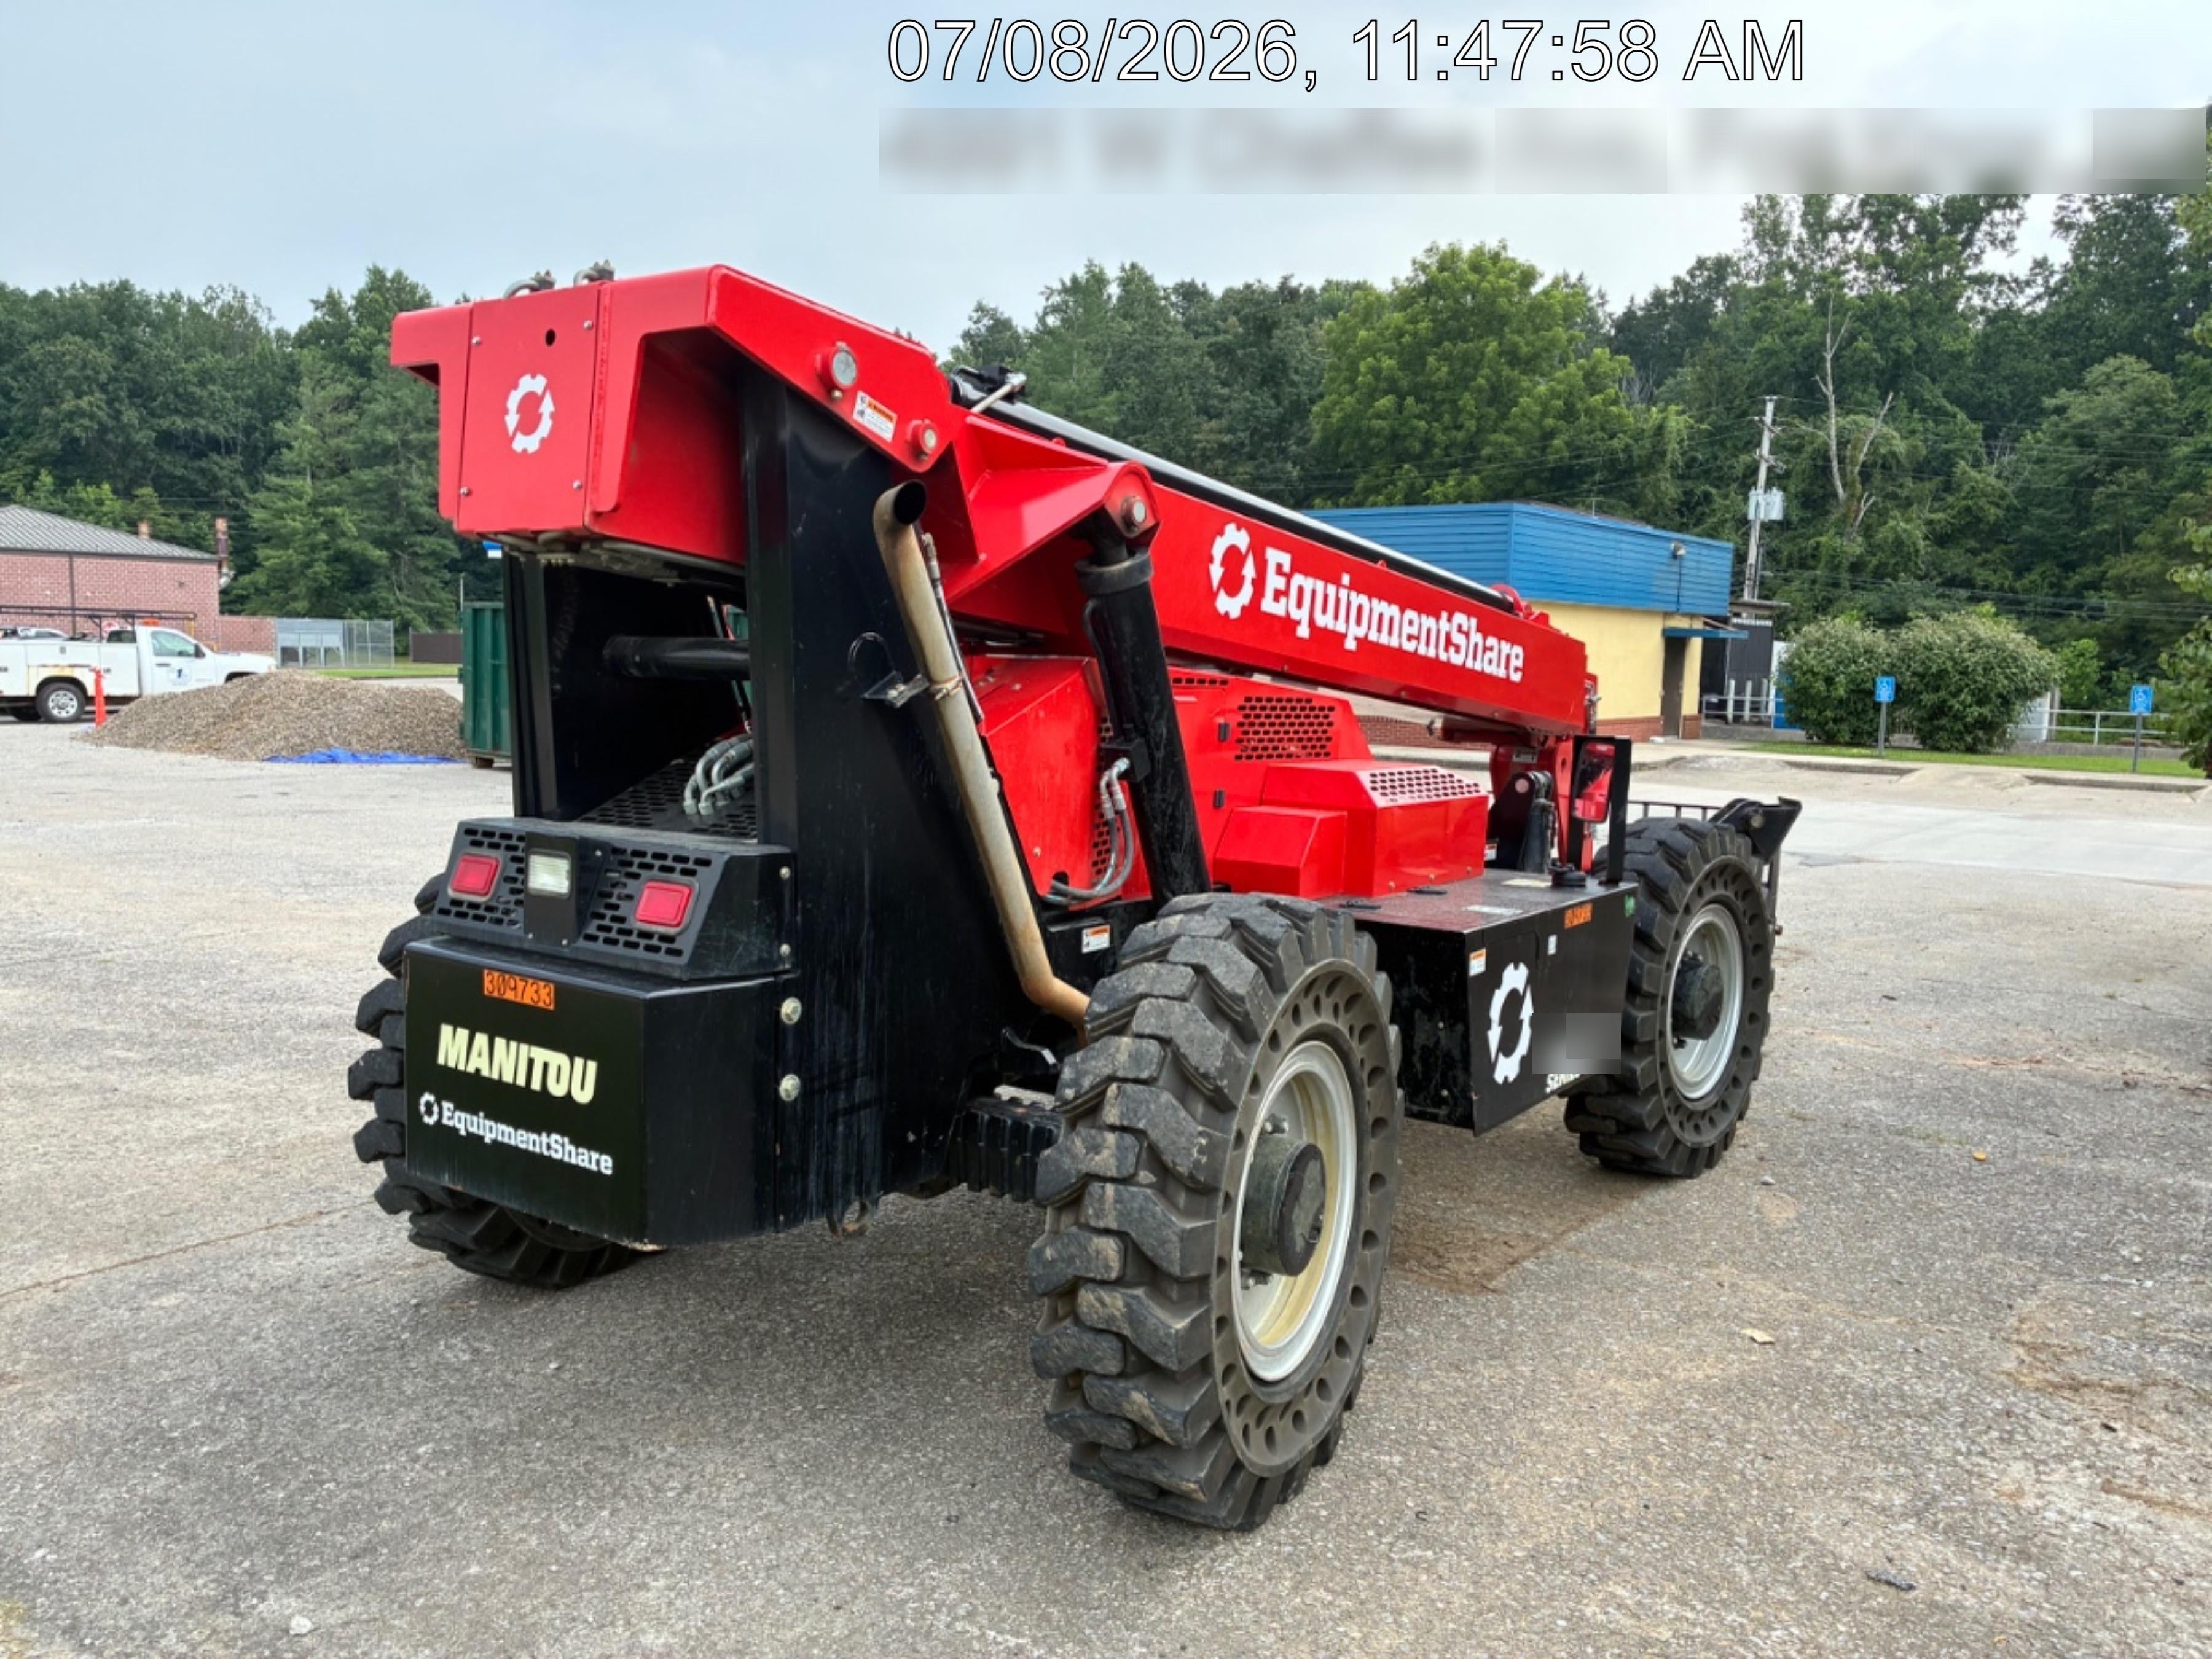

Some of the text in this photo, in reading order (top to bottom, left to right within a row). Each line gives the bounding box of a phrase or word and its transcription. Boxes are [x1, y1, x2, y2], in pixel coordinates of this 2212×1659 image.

[1260, 546, 1524, 683] EquipmentShare
[486, 972, 552, 1007] 309733
[437, 1023, 597, 1104] MANITOU
[442, 1100, 613, 1175] EquipmentShare
